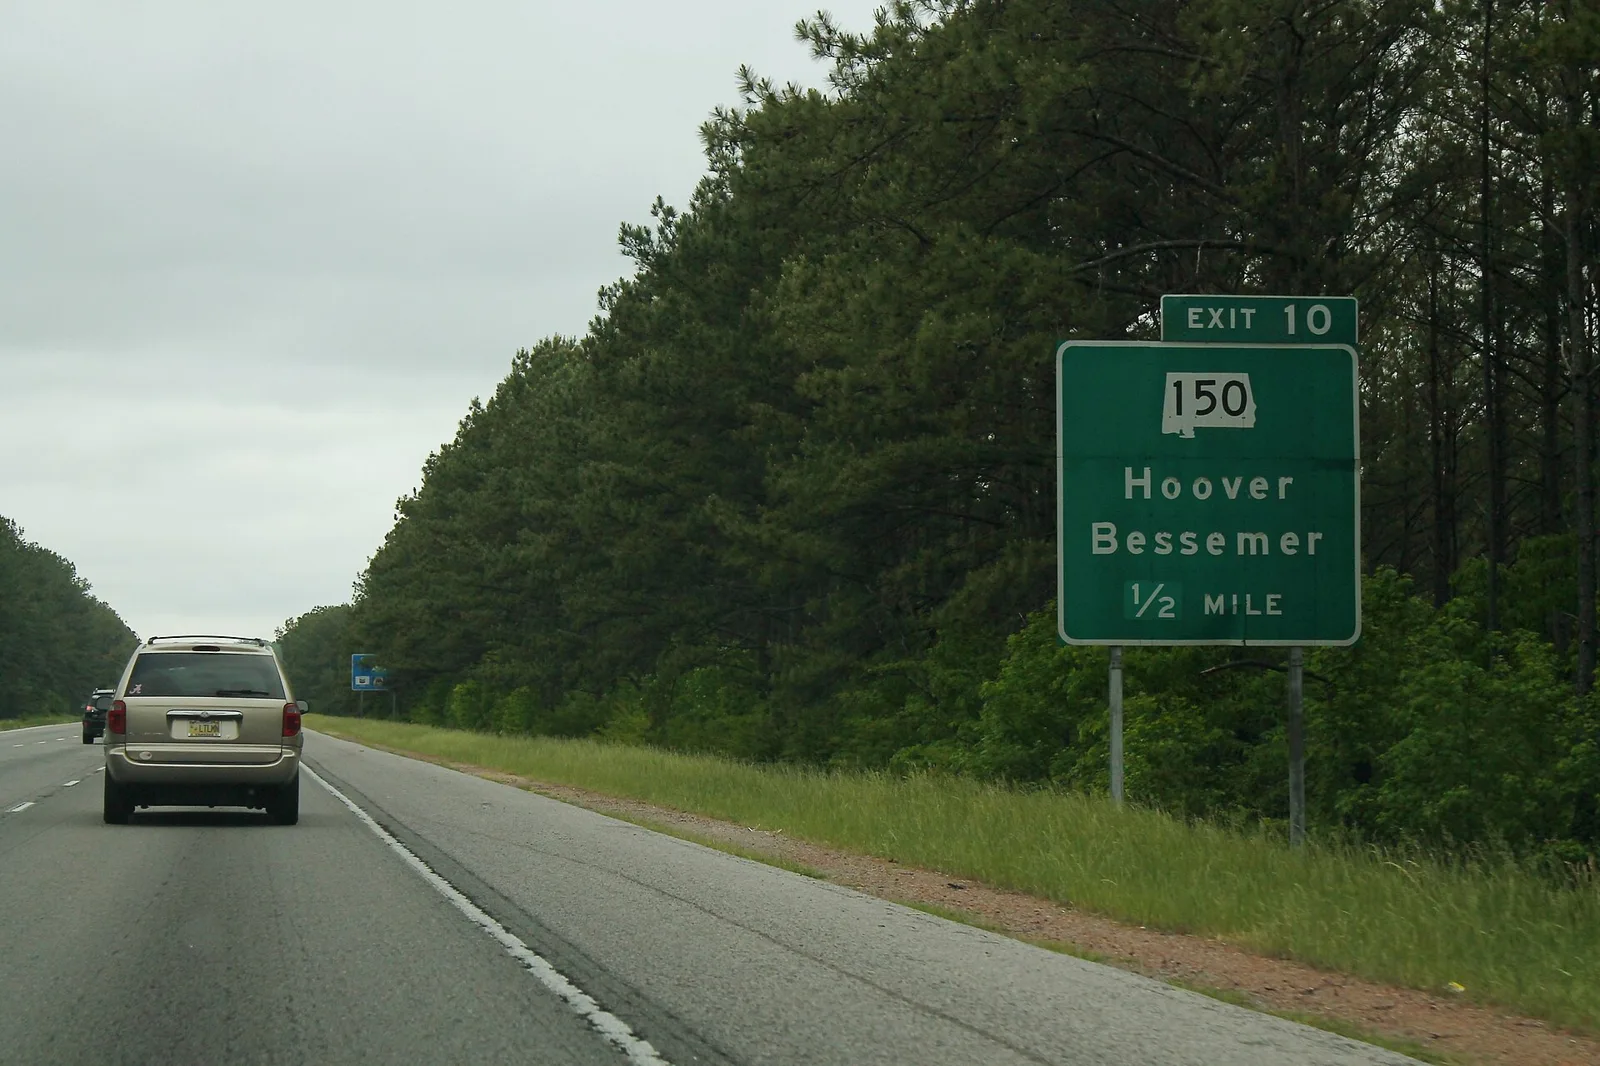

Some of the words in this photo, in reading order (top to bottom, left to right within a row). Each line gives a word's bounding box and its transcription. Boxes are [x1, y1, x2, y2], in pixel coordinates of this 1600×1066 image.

[1188, 308, 1256, 329] EXIT
[1284, 304, 1331, 335] 10
[1173, 380, 1247, 417] 150
[1125, 467, 1294, 500] Hoover
[1092, 522, 1322, 555] Bessemer
[1204, 594, 1282, 615] MILE
